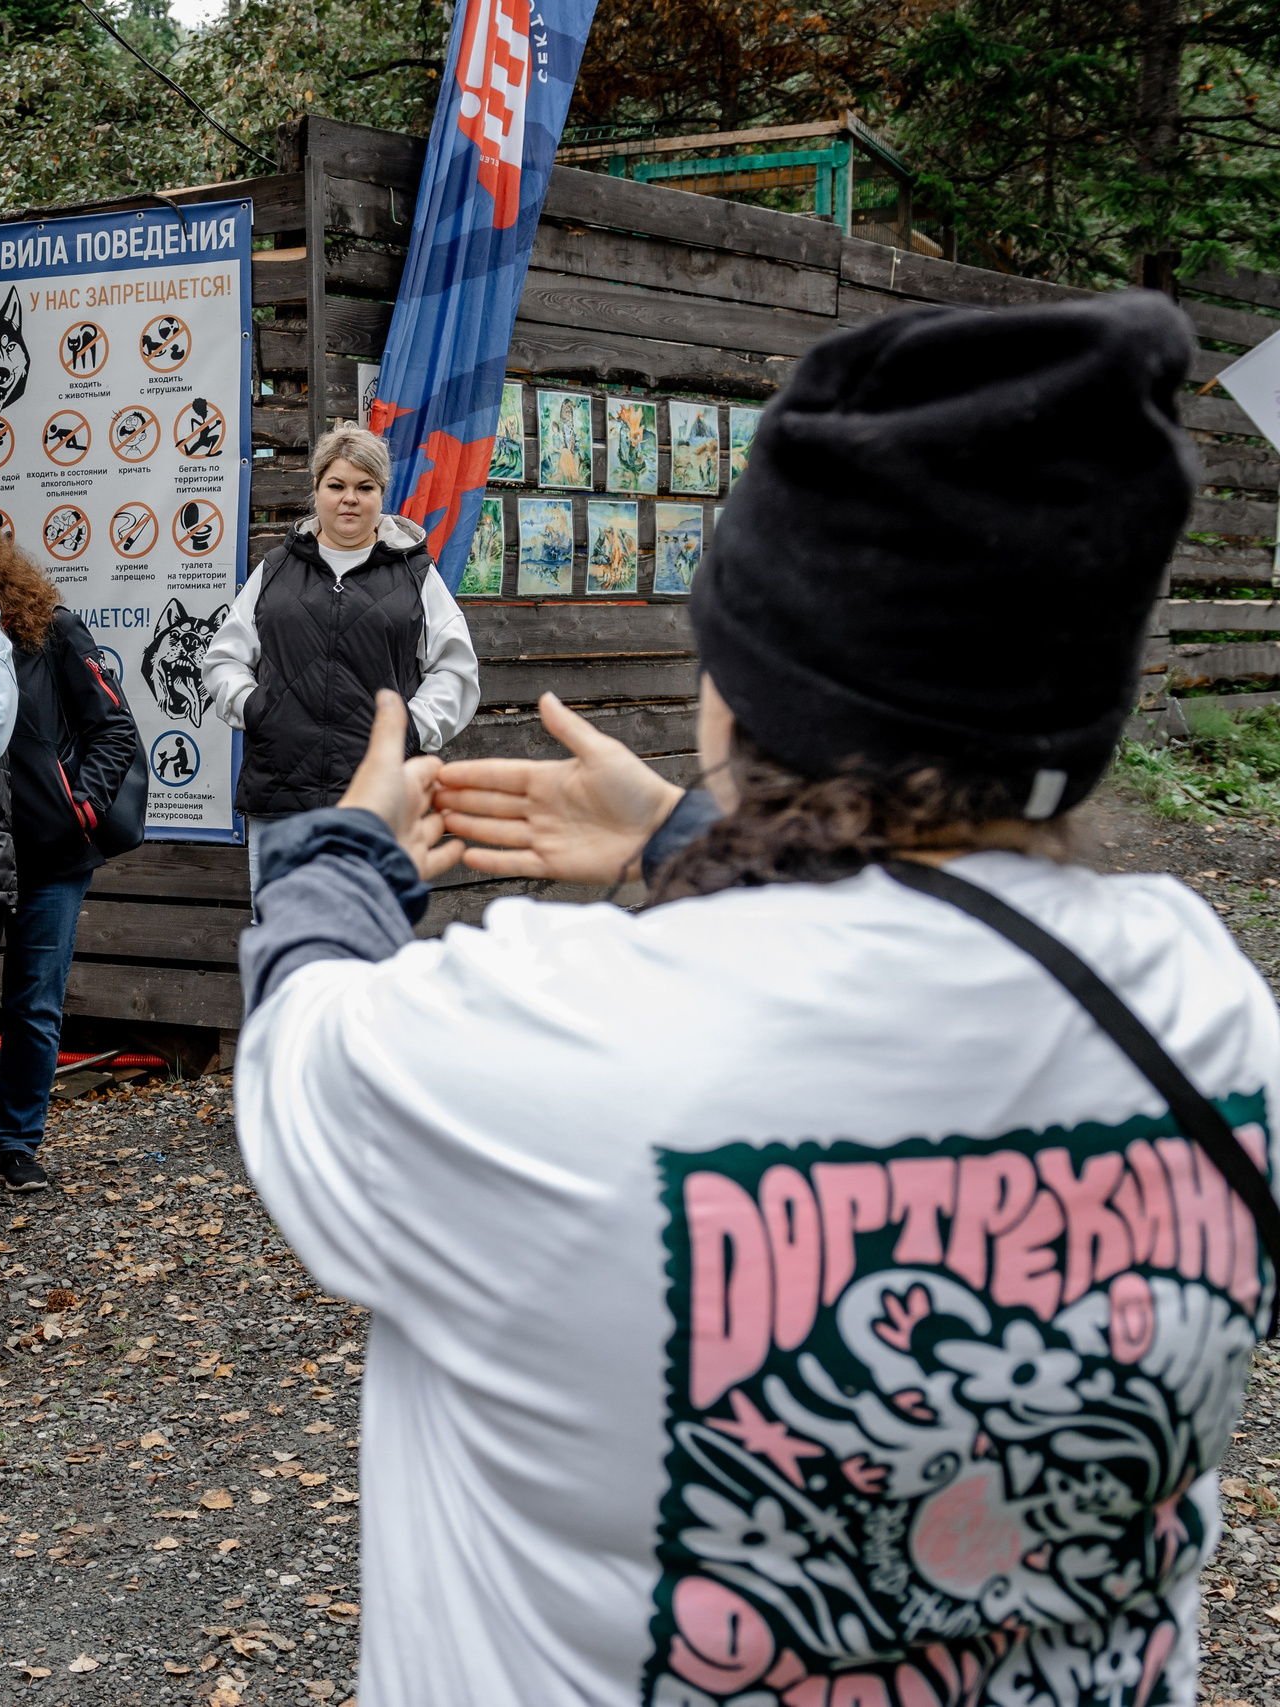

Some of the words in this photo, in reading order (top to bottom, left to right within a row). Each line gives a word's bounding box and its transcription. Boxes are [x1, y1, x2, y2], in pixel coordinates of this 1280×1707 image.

[76, 217, 235, 263] ПОВЕДЕНИЯ
[29, 291, 42, 312] У
[45, 288, 80, 311] НАС
[85, 275, 231, 308] ЗАПРЕЩАЕТСЯ!
[148, 376, 183, 384] входить
[69, 381, 102, 389] входить
[64, 390, 111, 399] животными
[146, 385, 193, 395] игрушками
[118, 467, 151, 475] кричать
[178, 464, 207, 473] бегать
[1, 474, 20, 482] едой
[26, 471, 58, 479] входить
[67, 468, 108, 477] состоянии
[41, 479, 93, 488] алкогольного
[174, 475, 224, 484] территории
[46, 490, 87, 498] опьянения
[176, 485, 222, 494] питомника
[115, 563, 149, 572] курение
[55, 575, 88, 584] драться
[110, 573, 156, 582] запрещено
[178, 572, 227, 580] территории
[167, 582, 211, 590] питомника
[148, 812, 203, 821] экскурсовода
